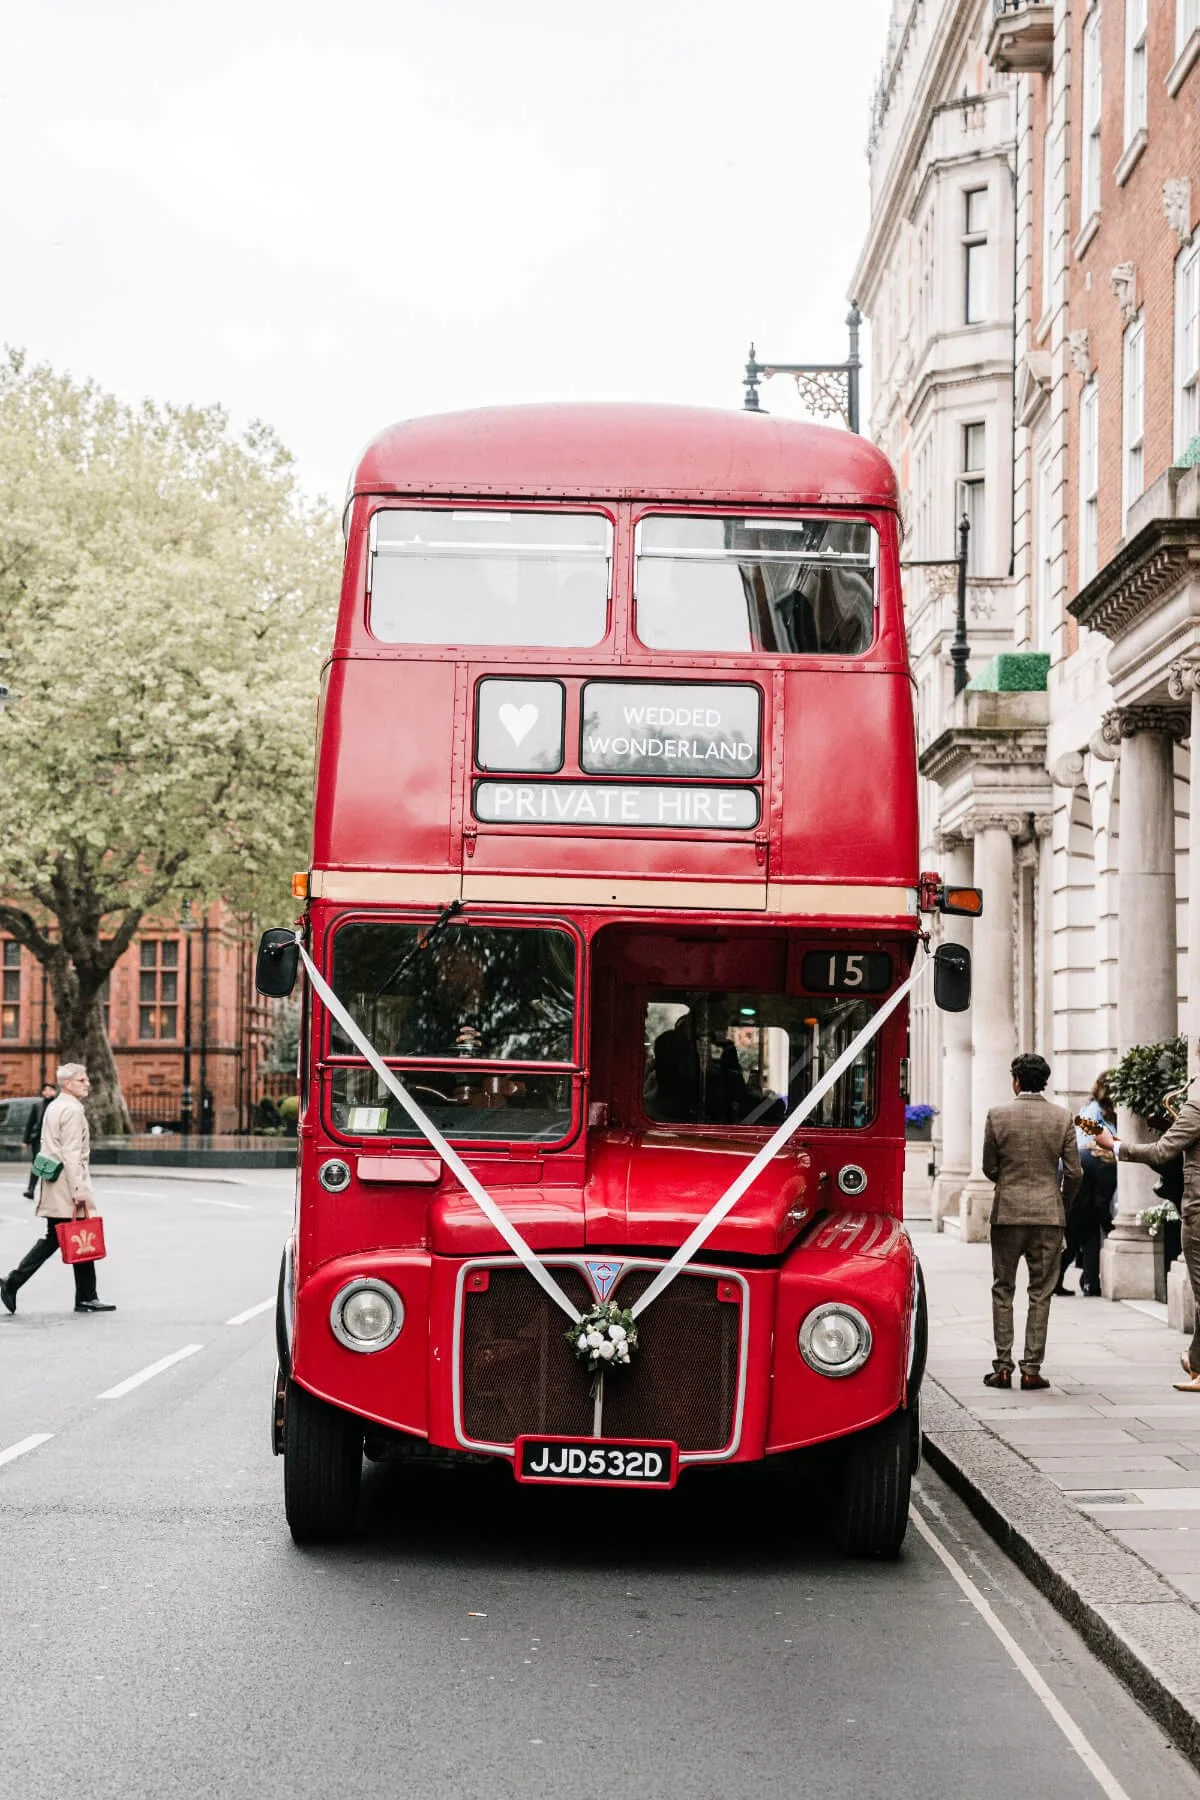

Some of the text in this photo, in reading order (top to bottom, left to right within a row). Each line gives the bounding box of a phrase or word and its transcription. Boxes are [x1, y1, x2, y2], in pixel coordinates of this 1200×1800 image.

[623, 706, 721, 728] WEDDED
[588, 736, 753, 761] WONDERLAND
[494, 786, 737, 822] PRIVATE HIRE
[828, 955, 865, 986] 15
[530, 1447, 663, 1477] JJD532D
